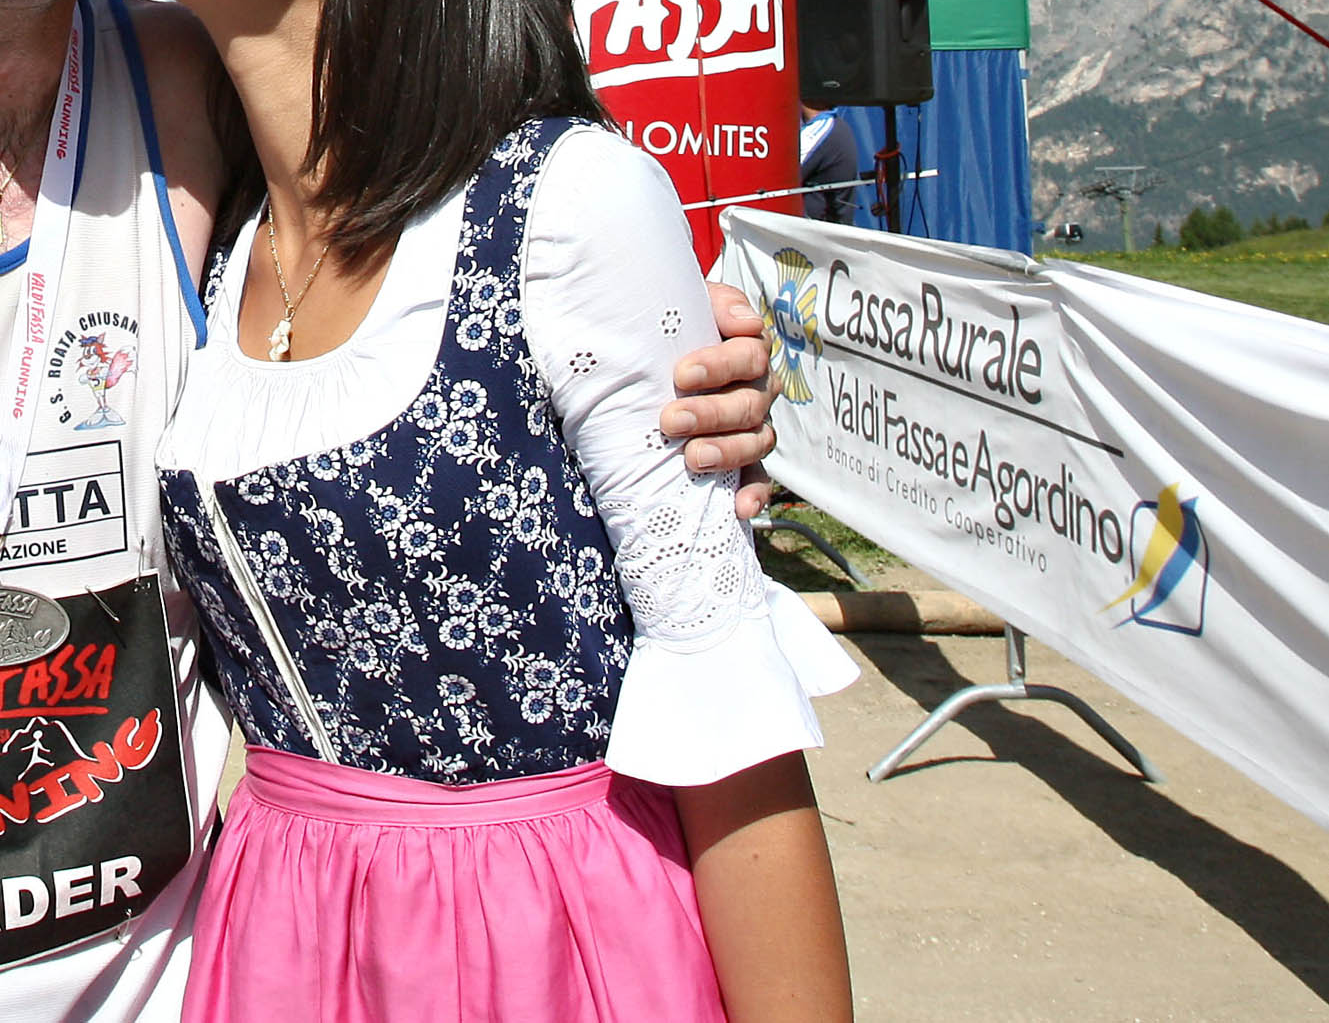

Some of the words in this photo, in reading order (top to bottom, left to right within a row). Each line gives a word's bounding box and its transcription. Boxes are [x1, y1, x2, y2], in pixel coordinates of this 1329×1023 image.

[56, 93, 74, 159] RUNNING
[47, 329, 77, 378] ROATA
[79, 311, 140, 338] CHIUSAN
[12, 346, 34, 419] RUNNING
[826, 435, 863, 476] Banca
[867, 456, 880, 485] di
[885, 468, 938, 515] Credito
[944, 497, 1047, 573] Cooperativo
